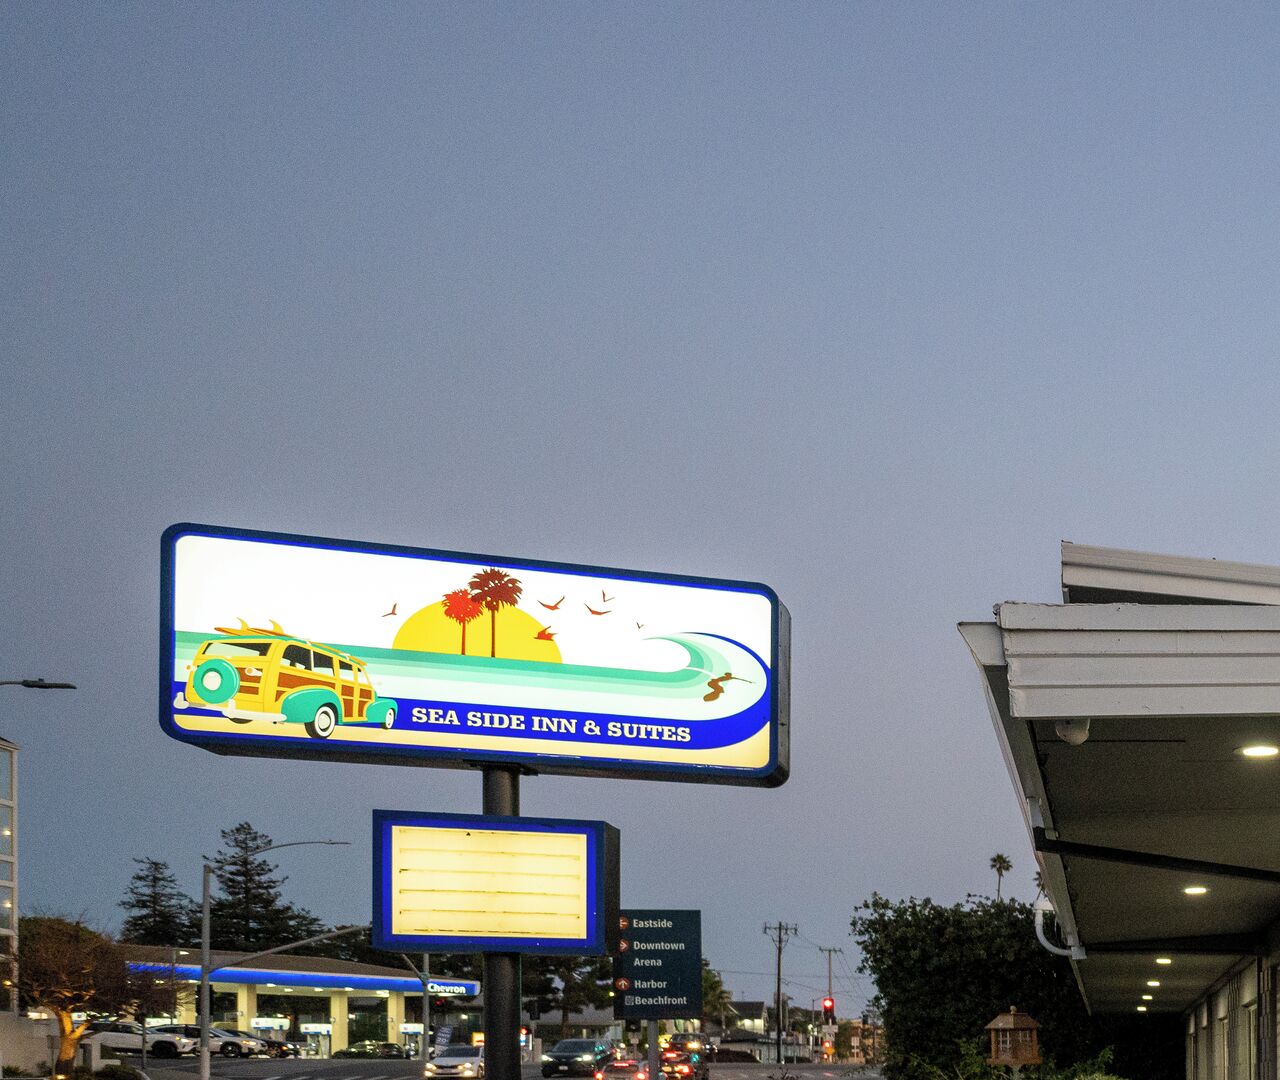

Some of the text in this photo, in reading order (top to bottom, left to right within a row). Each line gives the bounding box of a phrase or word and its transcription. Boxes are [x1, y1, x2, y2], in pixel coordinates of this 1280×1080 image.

[411, 707, 691, 742] SEA SIDE INN & SUITES
[632, 919, 673, 928] Eastside
[633, 941, 685, 950] Downtown
[633, 958, 662, 967] Arena
[427, 983, 466, 994] Chevron
[634, 980, 667, 989] Harbor
[634, 996, 688, 1005] Beachfront
